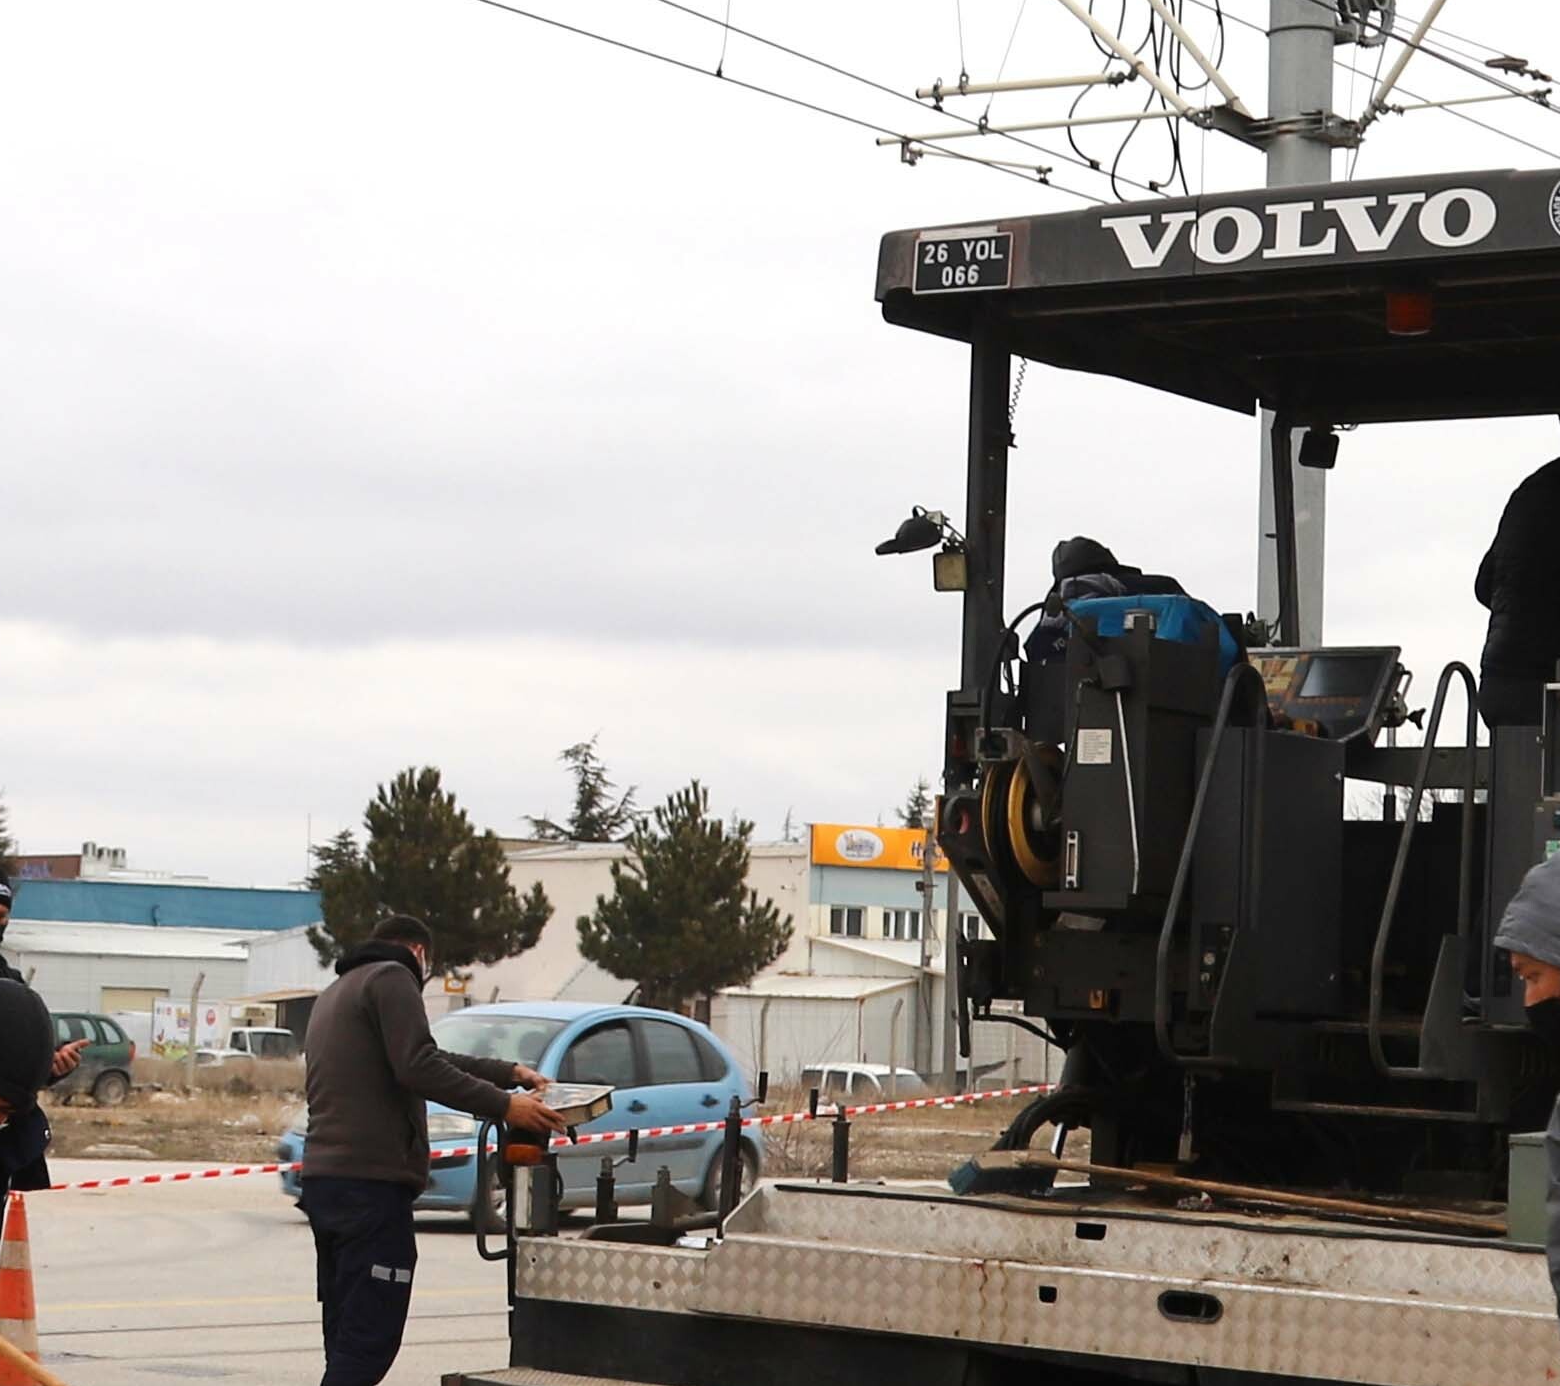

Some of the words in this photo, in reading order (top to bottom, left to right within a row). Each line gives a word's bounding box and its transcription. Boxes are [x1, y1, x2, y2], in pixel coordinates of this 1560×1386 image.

[1100, 187, 1498, 270] VOLVO
[924, 244, 949, 264] 26
[962, 240, 1003, 261] YOL
[942, 265, 980, 287] 066
